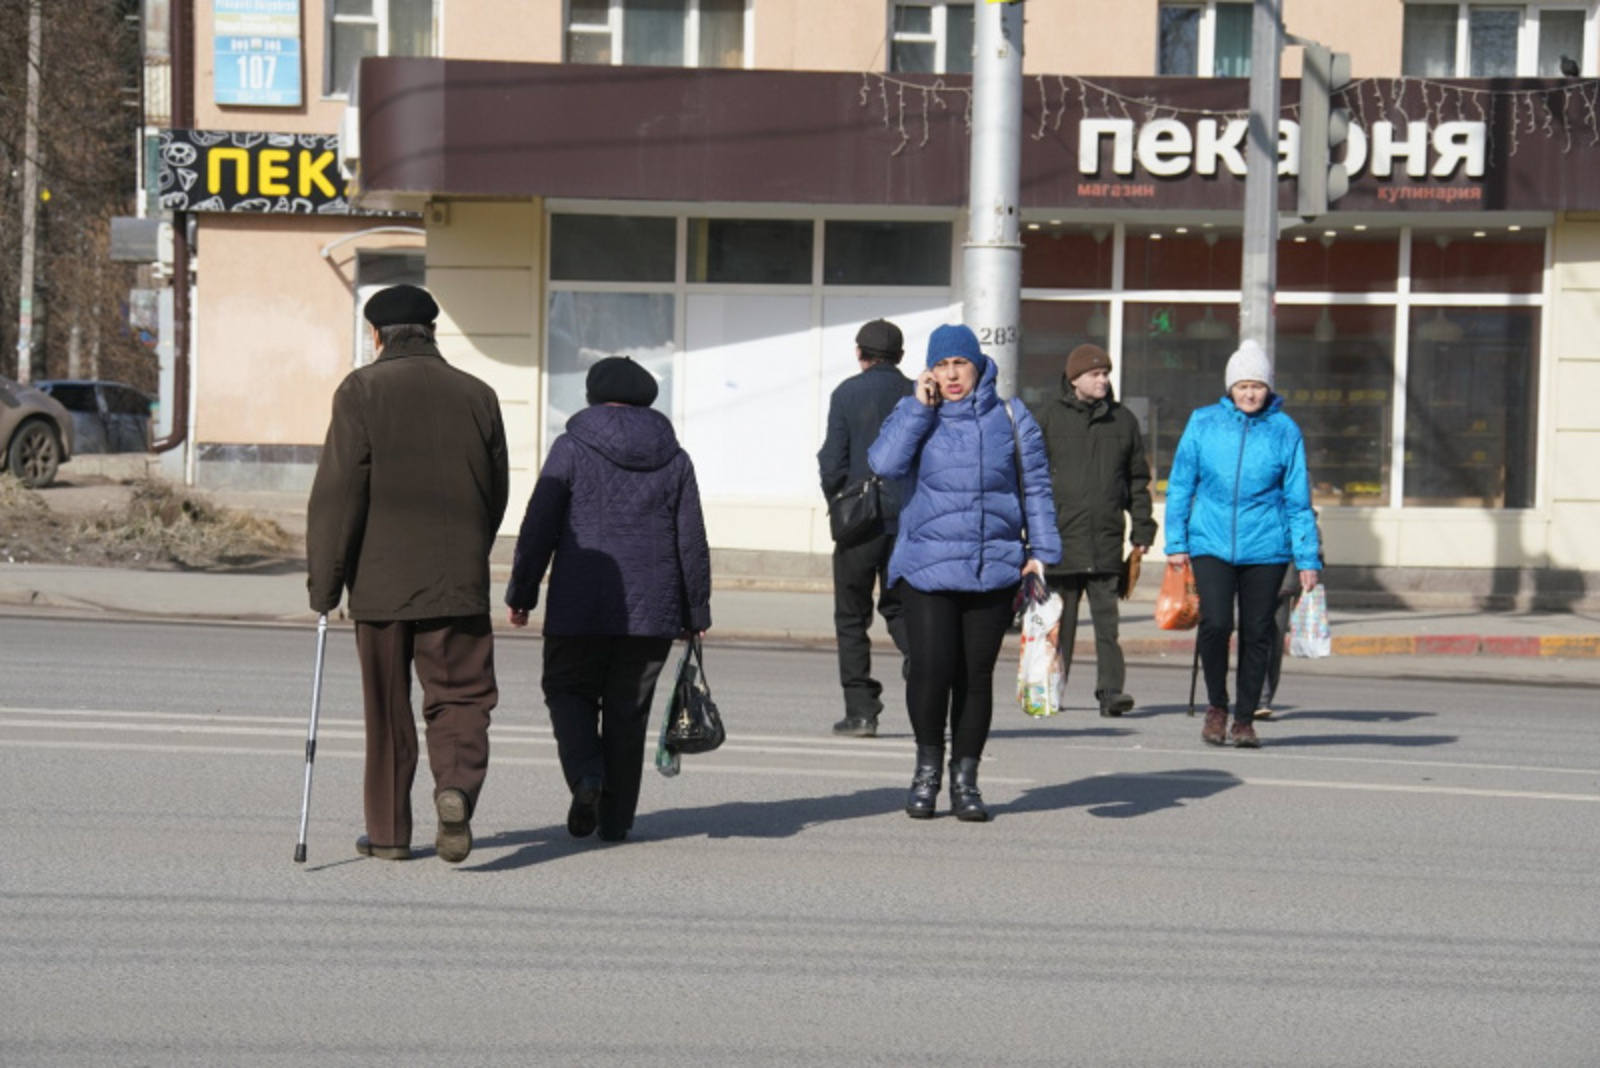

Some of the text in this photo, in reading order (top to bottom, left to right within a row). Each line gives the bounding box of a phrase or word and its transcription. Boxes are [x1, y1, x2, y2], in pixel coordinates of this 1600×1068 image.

[237, 54, 276, 89] 107
[207, 148, 353, 198] ПЕК
[1077, 183, 1155, 197] магазин
[1377, 186, 1482, 202] кулинария
[980, 326, 1018, 346] 283
